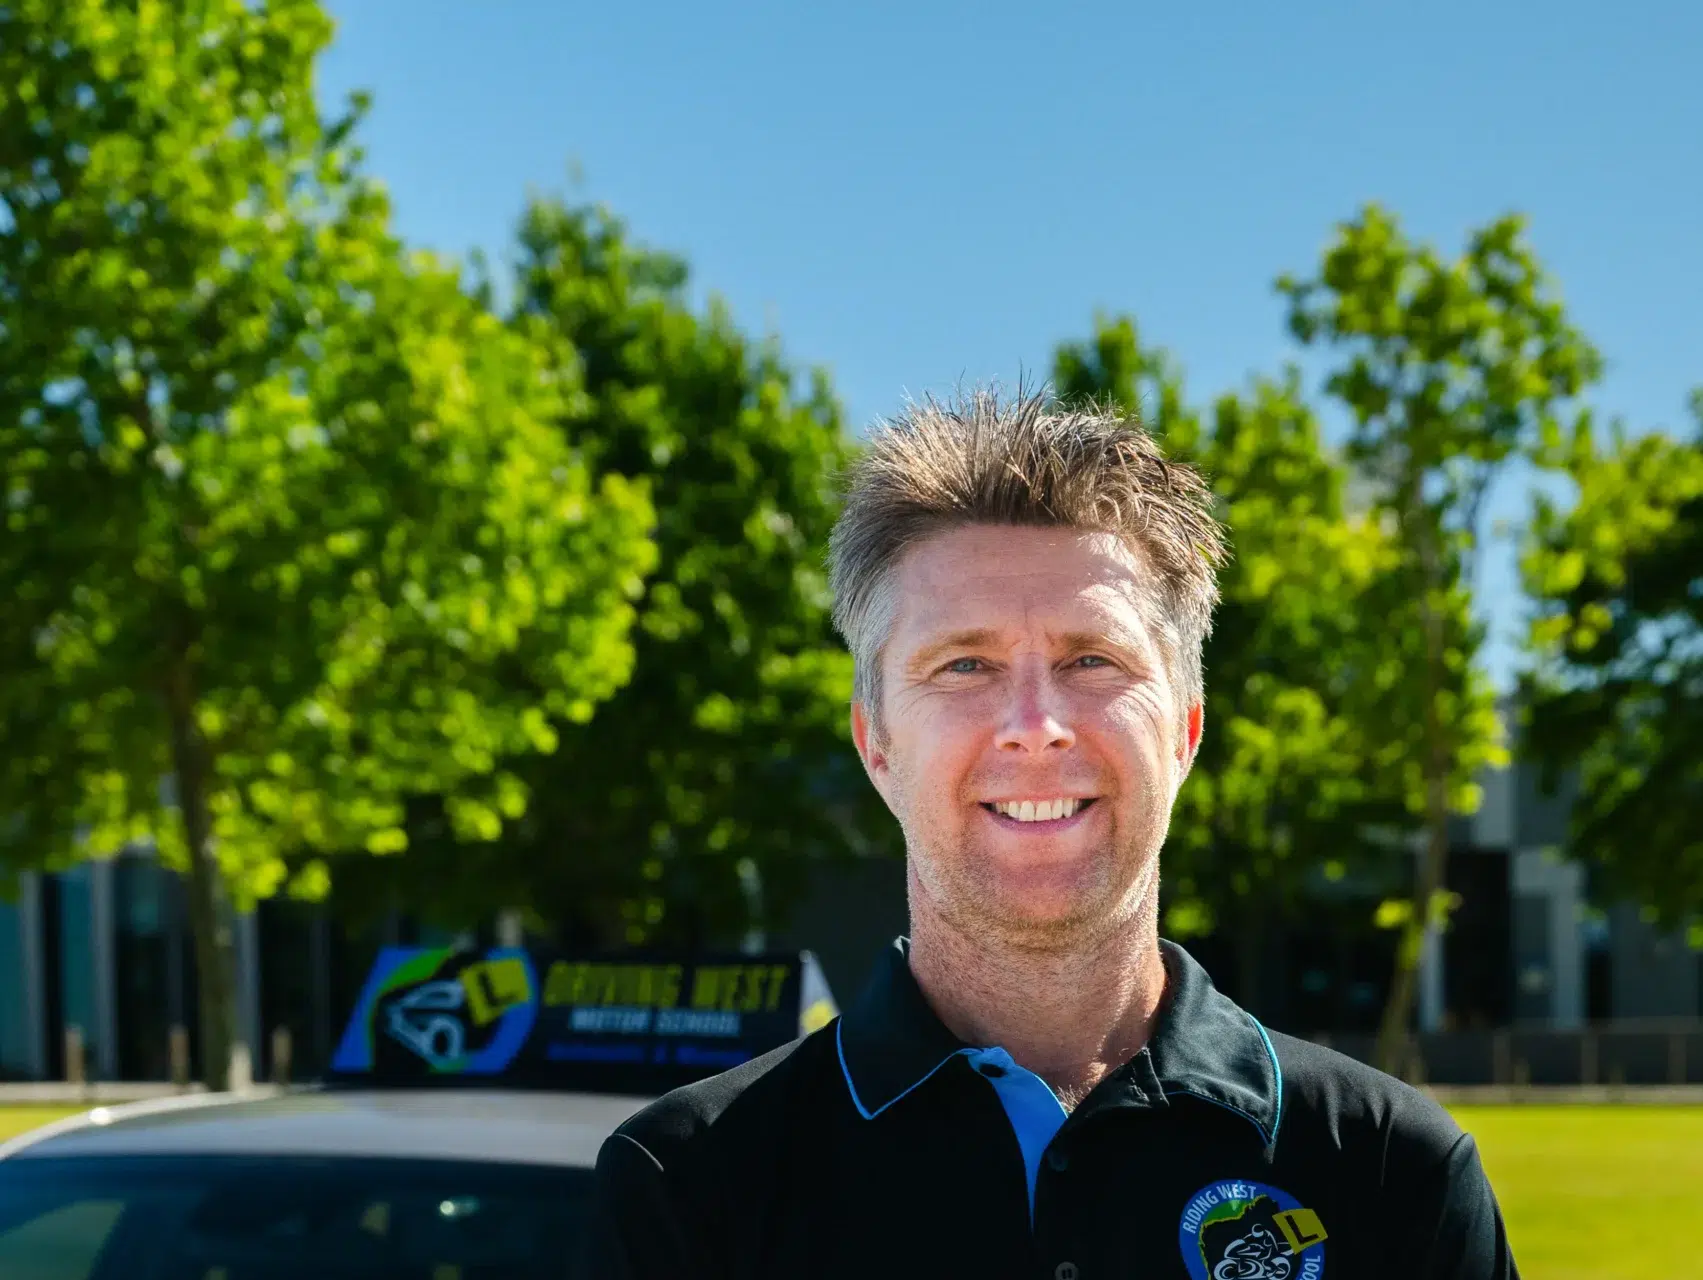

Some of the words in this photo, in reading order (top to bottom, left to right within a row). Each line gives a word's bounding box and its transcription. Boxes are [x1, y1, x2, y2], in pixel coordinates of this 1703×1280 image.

[478, 967, 517, 1007] L
[543, 961, 682, 1006] DRIVING
[691, 965, 789, 1012] WEST
[571, 1006, 650, 1032] MOTOR
[654, 1009, 741, 1036] SCHOOL
[1182, 1190, 1220, 1234] RIDING
[1216, 1183, 1257, 1200] WEST
[1285, 1214, 1319, 1245] L
